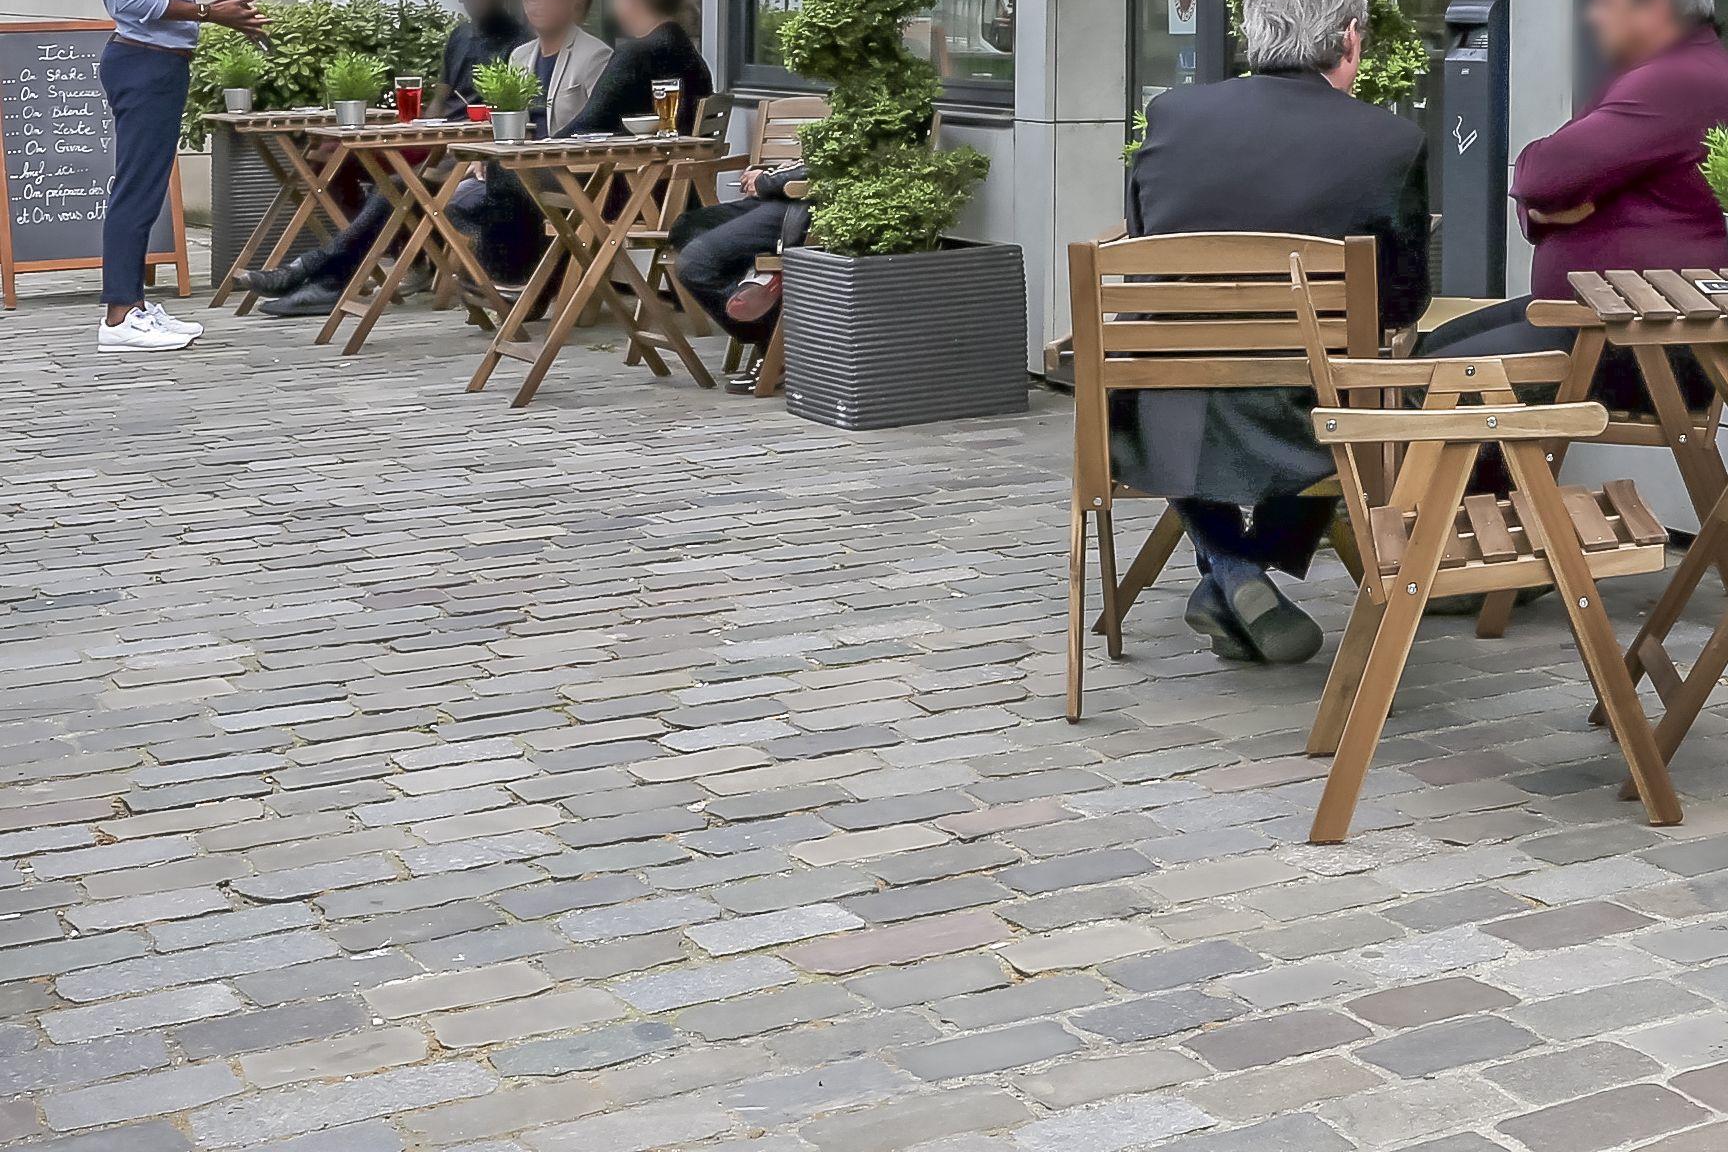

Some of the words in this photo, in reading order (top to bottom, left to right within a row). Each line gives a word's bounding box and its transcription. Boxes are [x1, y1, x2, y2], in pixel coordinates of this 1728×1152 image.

[16, 207, 30, 225] et
[32, 206, 54, 224] On
[57, 210, 83, 222] vous
[87, 199, 108, 220] att
